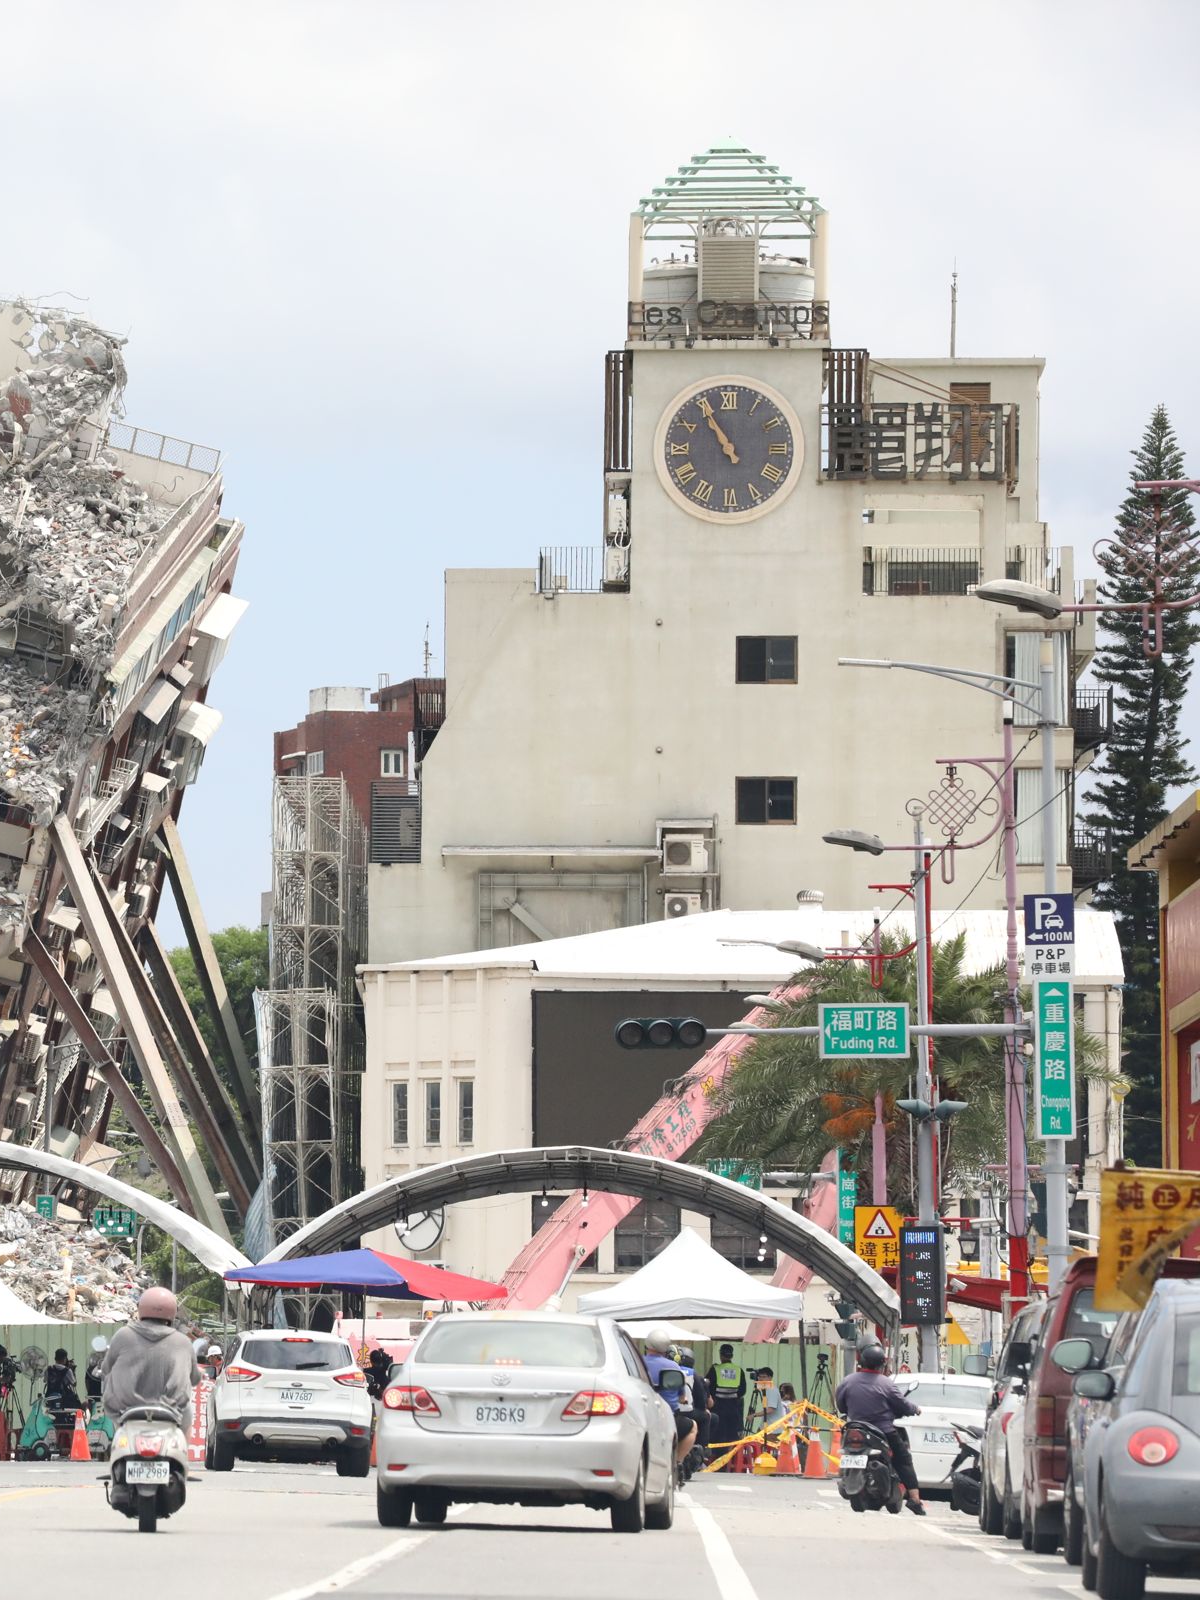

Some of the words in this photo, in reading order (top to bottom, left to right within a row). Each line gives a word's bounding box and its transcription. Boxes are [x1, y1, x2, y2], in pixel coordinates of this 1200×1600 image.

[628, 301, 683, 325] Les
[698, 300, 829, 333] Champs
[1034, 898, 1057, 930] P
[1044, 931, 1073, 941] 100M
[1035, 948, 1066, 960] P&P
[1031, 961, 1071, 975] 停車場
[831, 1010, 897, 1031] 福町路
[831, 1036, 874, 1053] Fuding
[878, 1036, 898, 1049] Rd.
[1044, 1003, 1066, 1080] 重慶路
